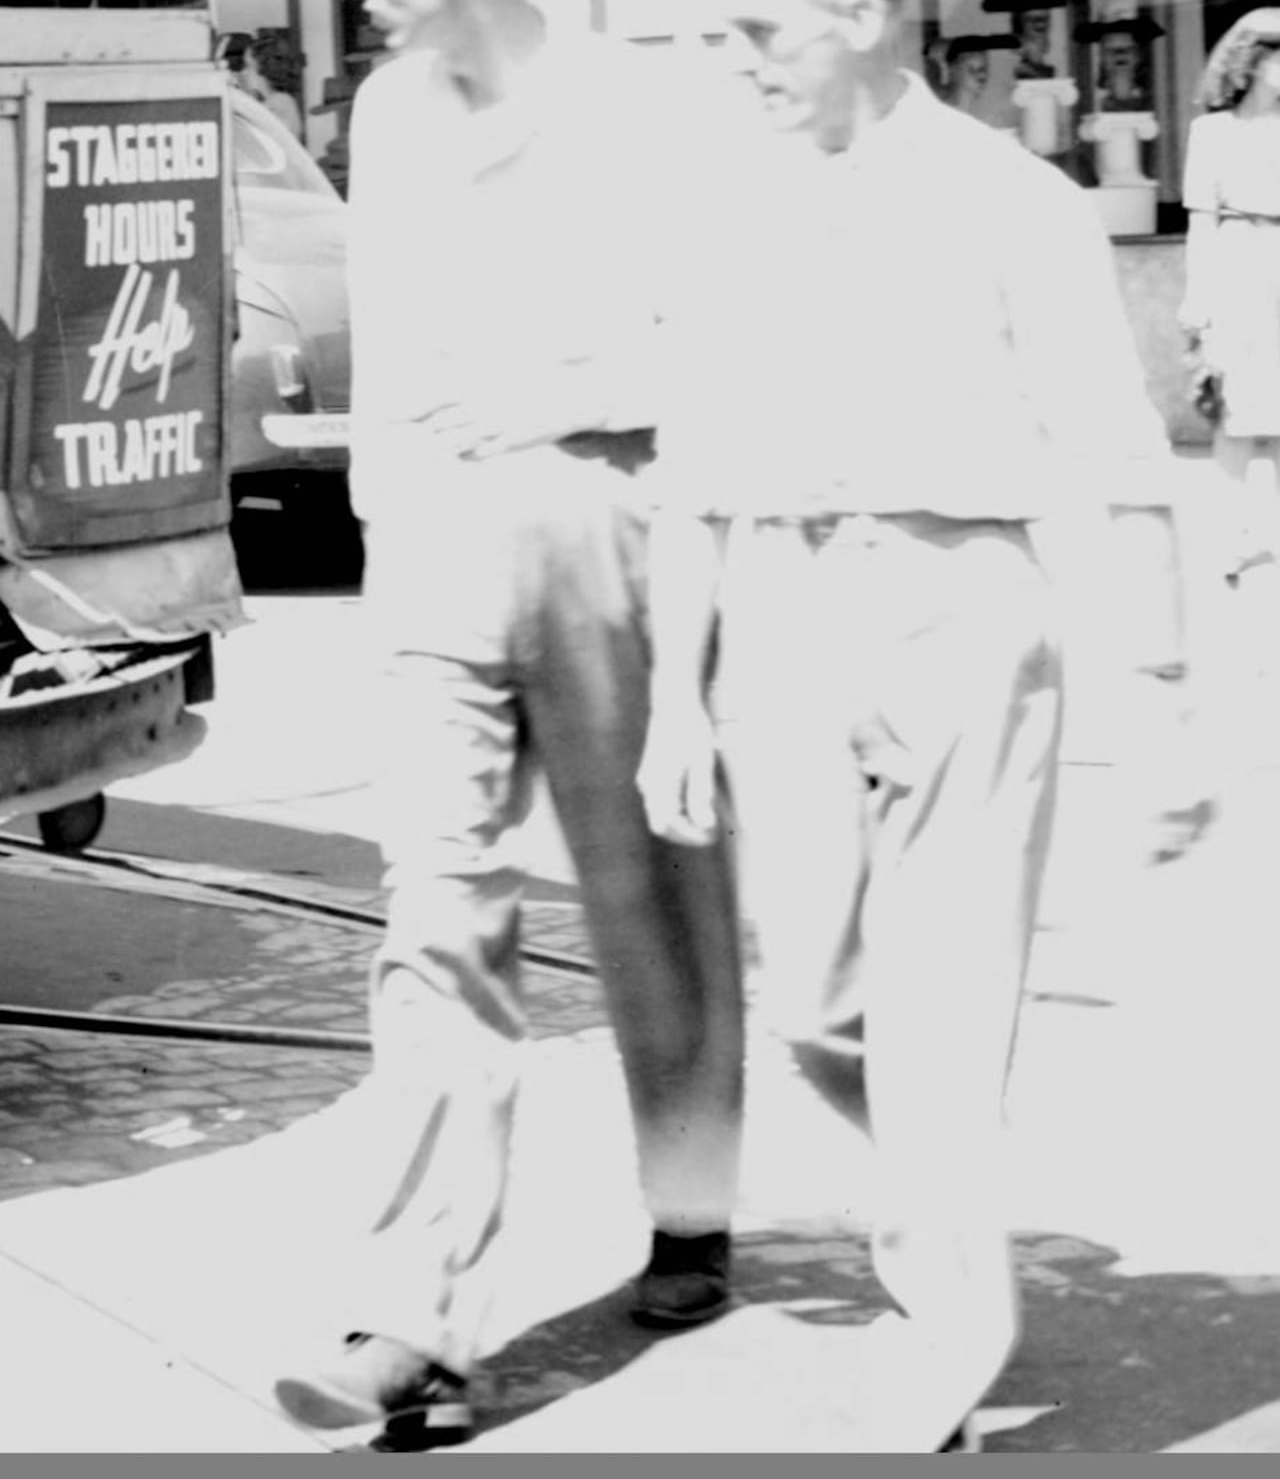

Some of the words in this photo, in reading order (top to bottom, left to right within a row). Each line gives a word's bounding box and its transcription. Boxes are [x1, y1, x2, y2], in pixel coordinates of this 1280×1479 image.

[46, 121, 219, 188] STAGGERED
[83, 199, 195, 267] HOURS
[53, 410, 203, 489] TRAFFIC
